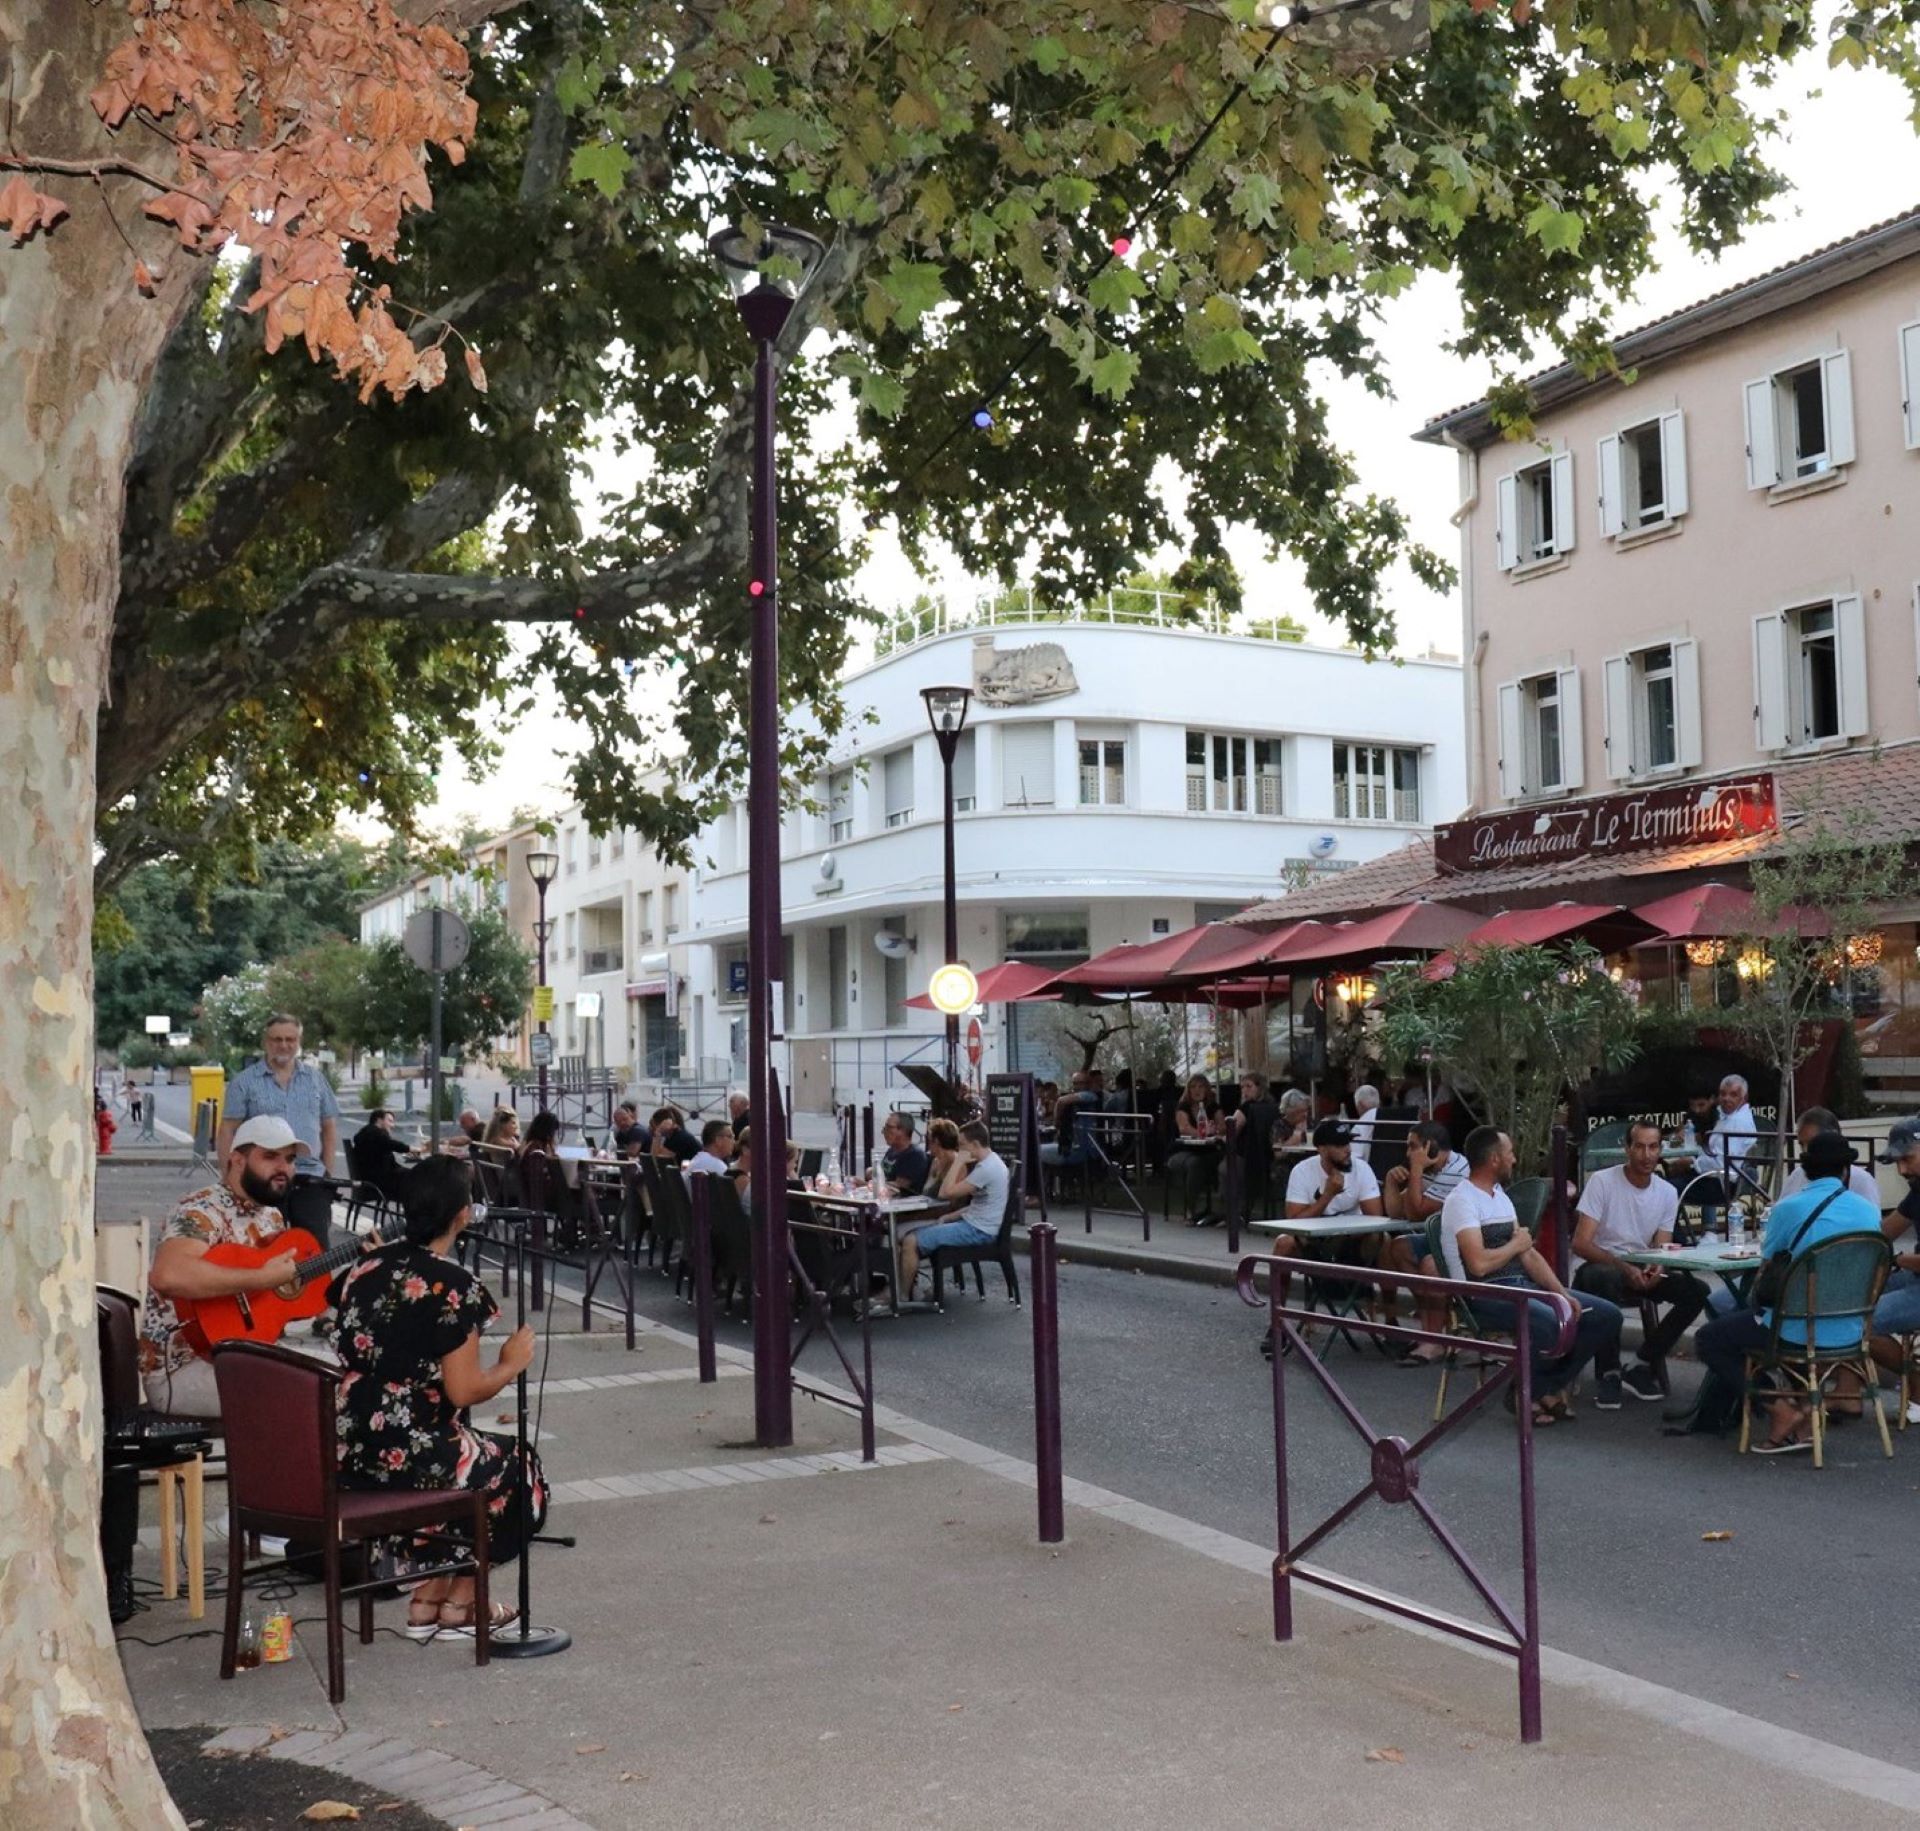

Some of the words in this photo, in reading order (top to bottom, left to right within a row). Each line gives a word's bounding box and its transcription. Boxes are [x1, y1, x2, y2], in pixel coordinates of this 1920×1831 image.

[1469, 820, 1583, 862] Restaurant
[1590, 807, 1620, 847] Le
[1624, 796, 1736, 841] Terminus
